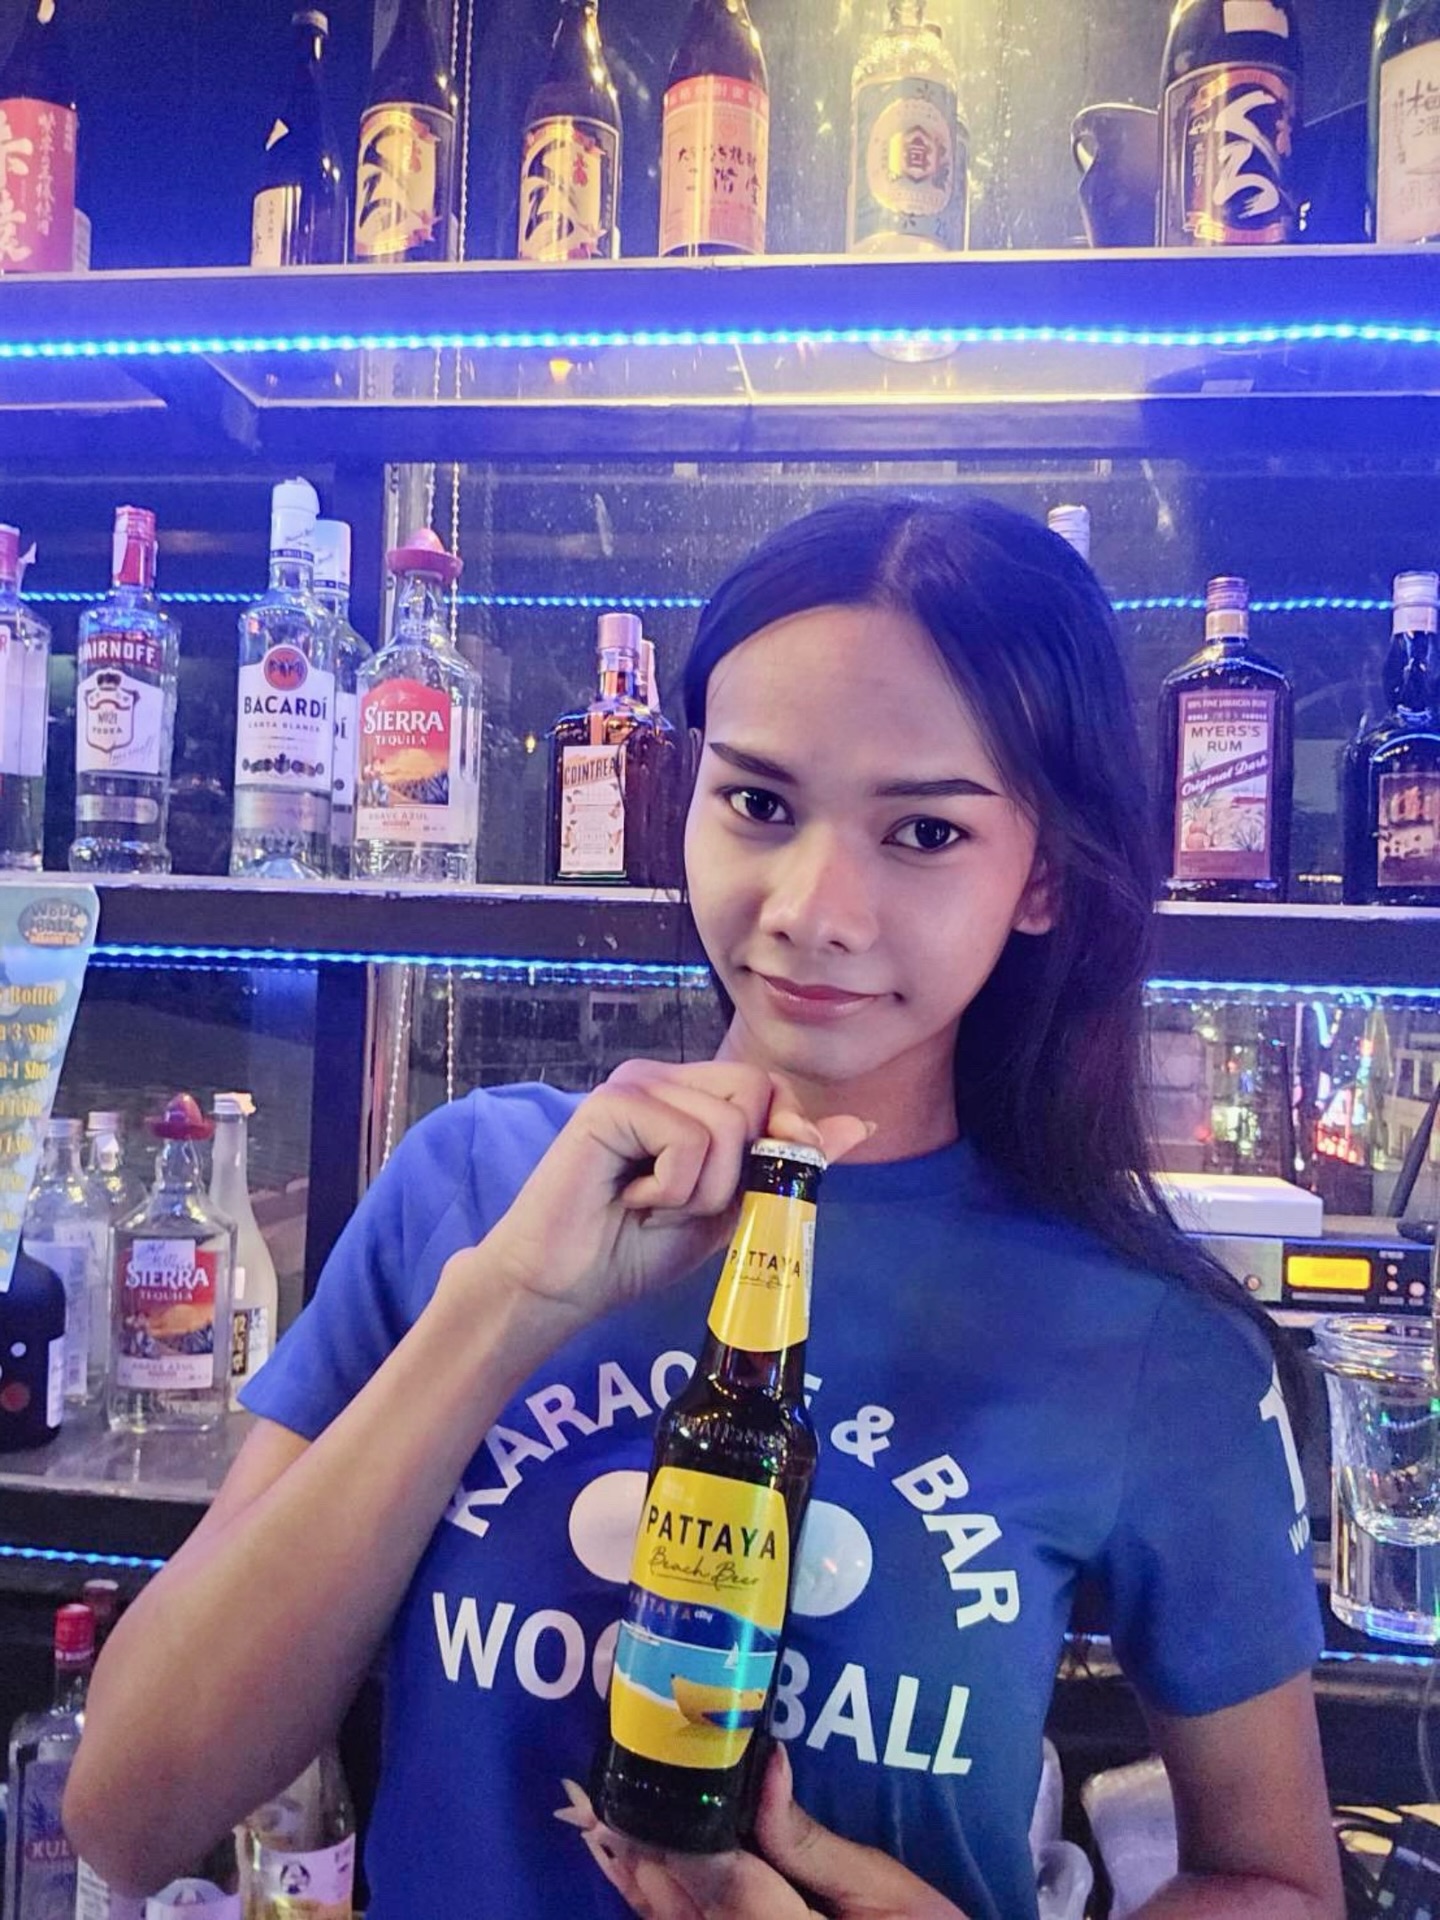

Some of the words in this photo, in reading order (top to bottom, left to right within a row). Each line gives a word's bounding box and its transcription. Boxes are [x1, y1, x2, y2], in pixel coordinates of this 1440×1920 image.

[244, 696, 327, 719] BACARDÍ
[364, 701, 444, 734] SIERRA
[1191, 725, 1261, 738] MYERS'S
[1207, 740, 1242, 753] RUM
[1182, 766, 1233, 797] Original
[126, 1261, 209, 1290] SIERRA
[730, 1250, 800, 1278] PTTAYA
[831, 1403, 895, 1468] &
[893, 1454, 1021, 1630] BAR
[647, 1505, 775, 1560] PATTAYA
[650, 1545, 710, 1577] Beach
[711, 1561, 760, 1592] Beer
